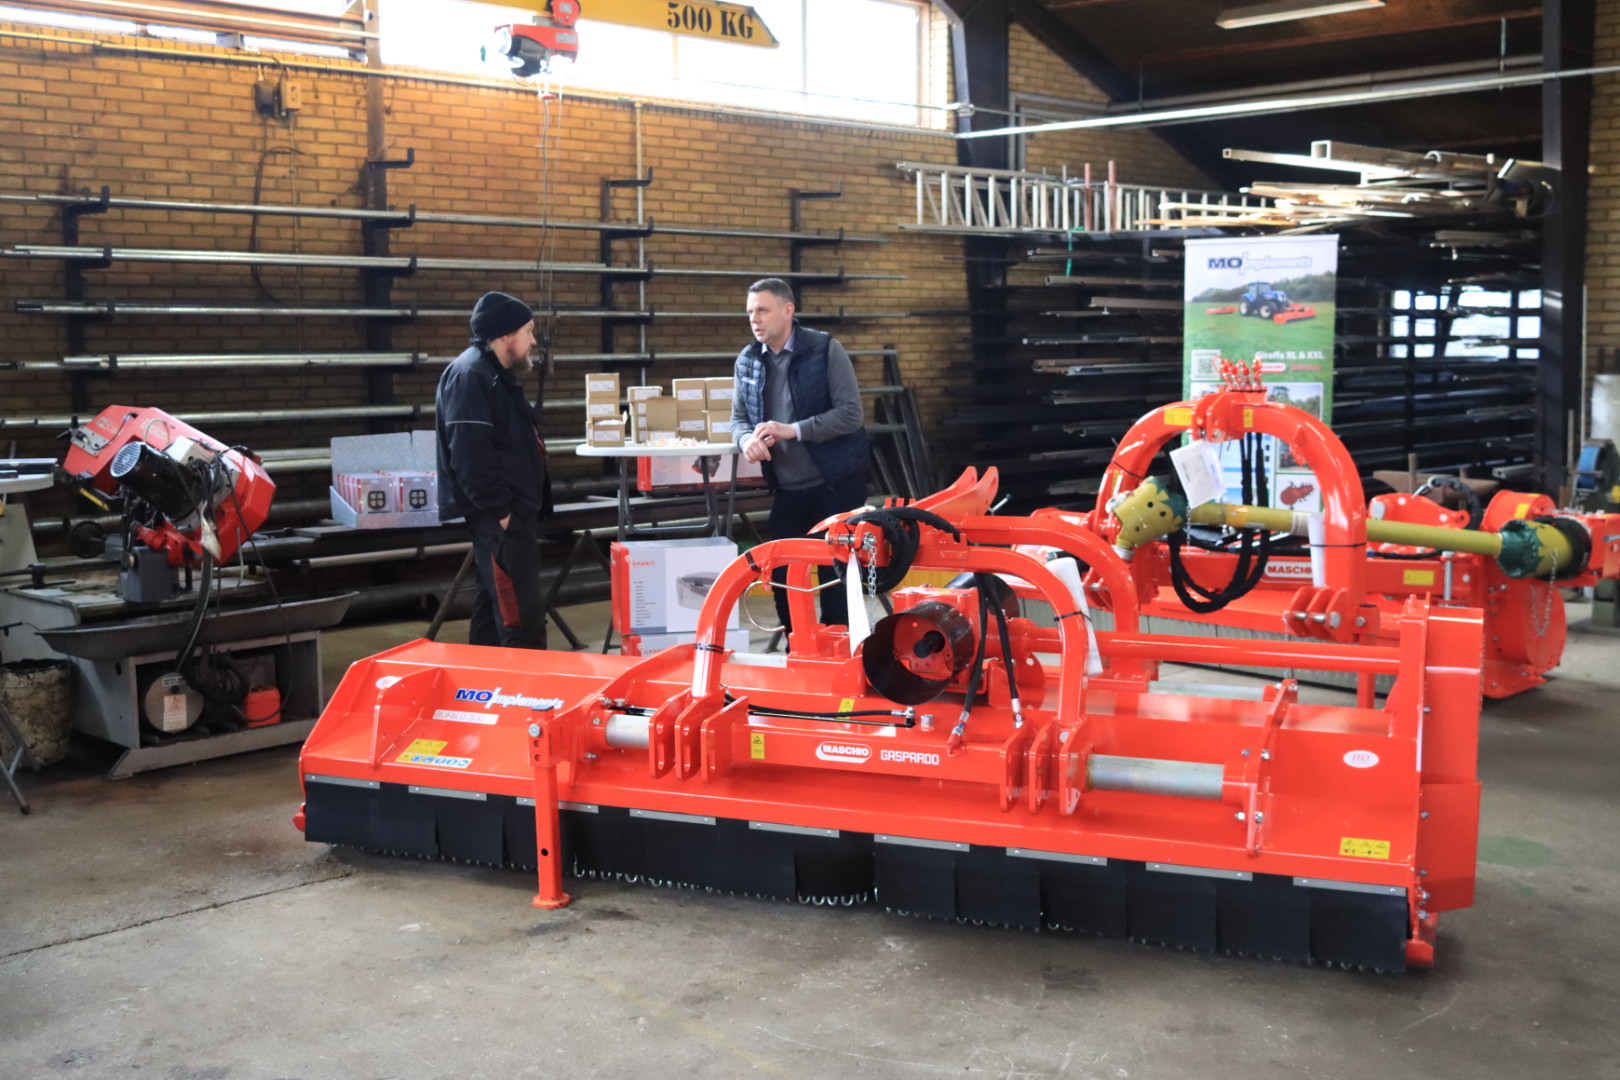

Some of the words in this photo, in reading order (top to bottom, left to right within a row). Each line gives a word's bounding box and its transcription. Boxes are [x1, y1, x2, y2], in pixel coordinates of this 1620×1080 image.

[667, 2, 712, 33] 500
[720, 10, 754, 39] KG
[434, 709, 467, 721] BUFALO
[822, 744, 870, 757] MASCHIO
[880, 749, 940, 766] GASPARDO
